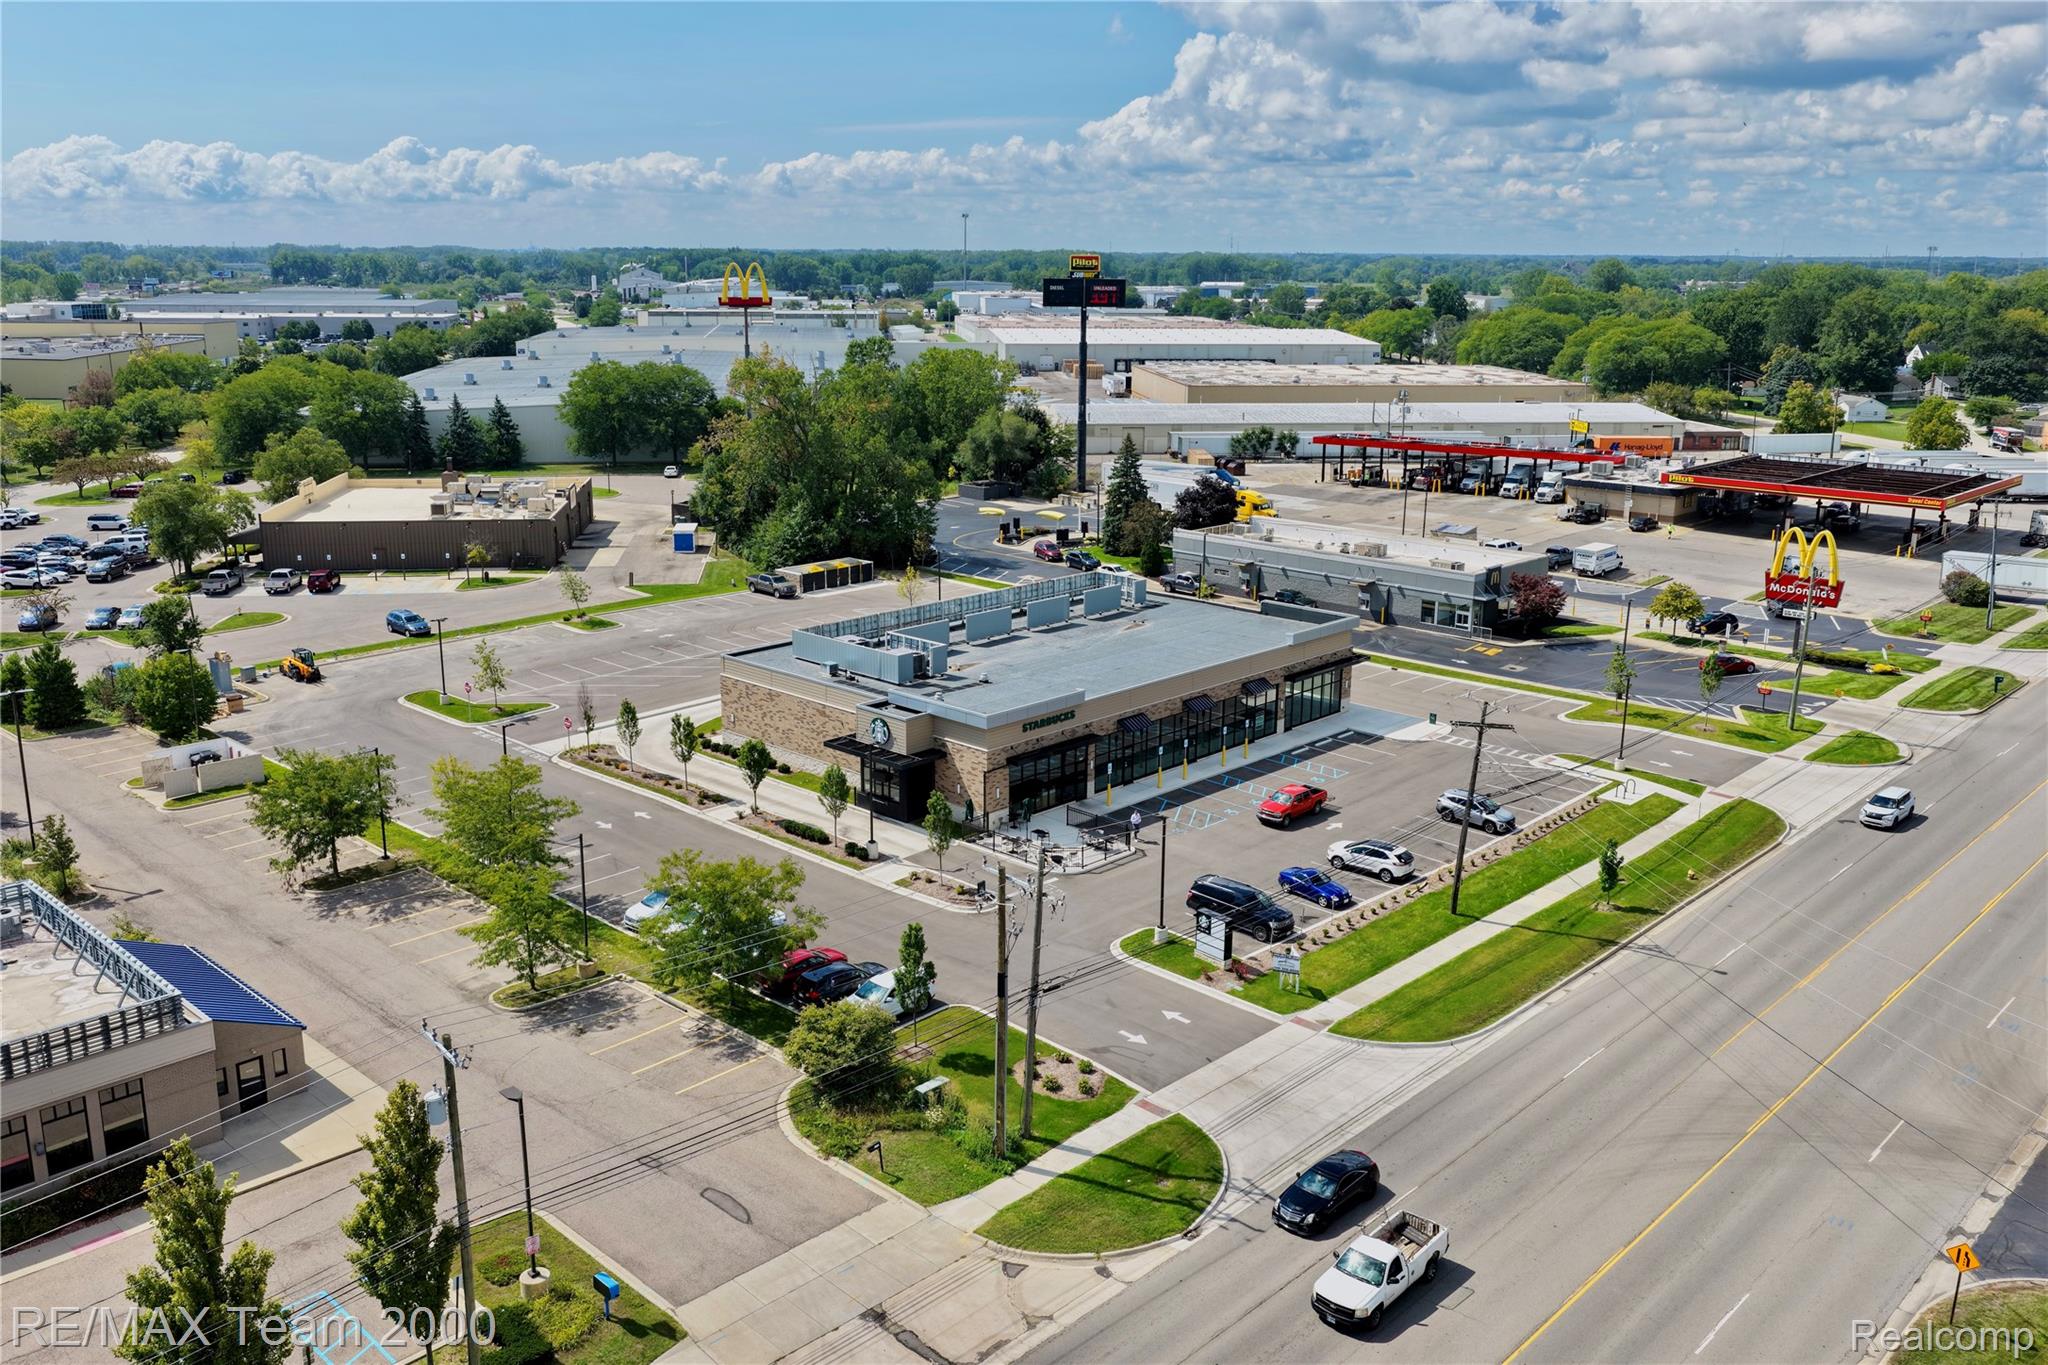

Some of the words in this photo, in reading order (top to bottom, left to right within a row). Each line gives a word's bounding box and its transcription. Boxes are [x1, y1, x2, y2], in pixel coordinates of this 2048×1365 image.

[1072, 257, 1098, 267] Pilot
[1668, 474, 1695, 483] Pilot
[1022, 709, 1076, 733] STARBUCKS
